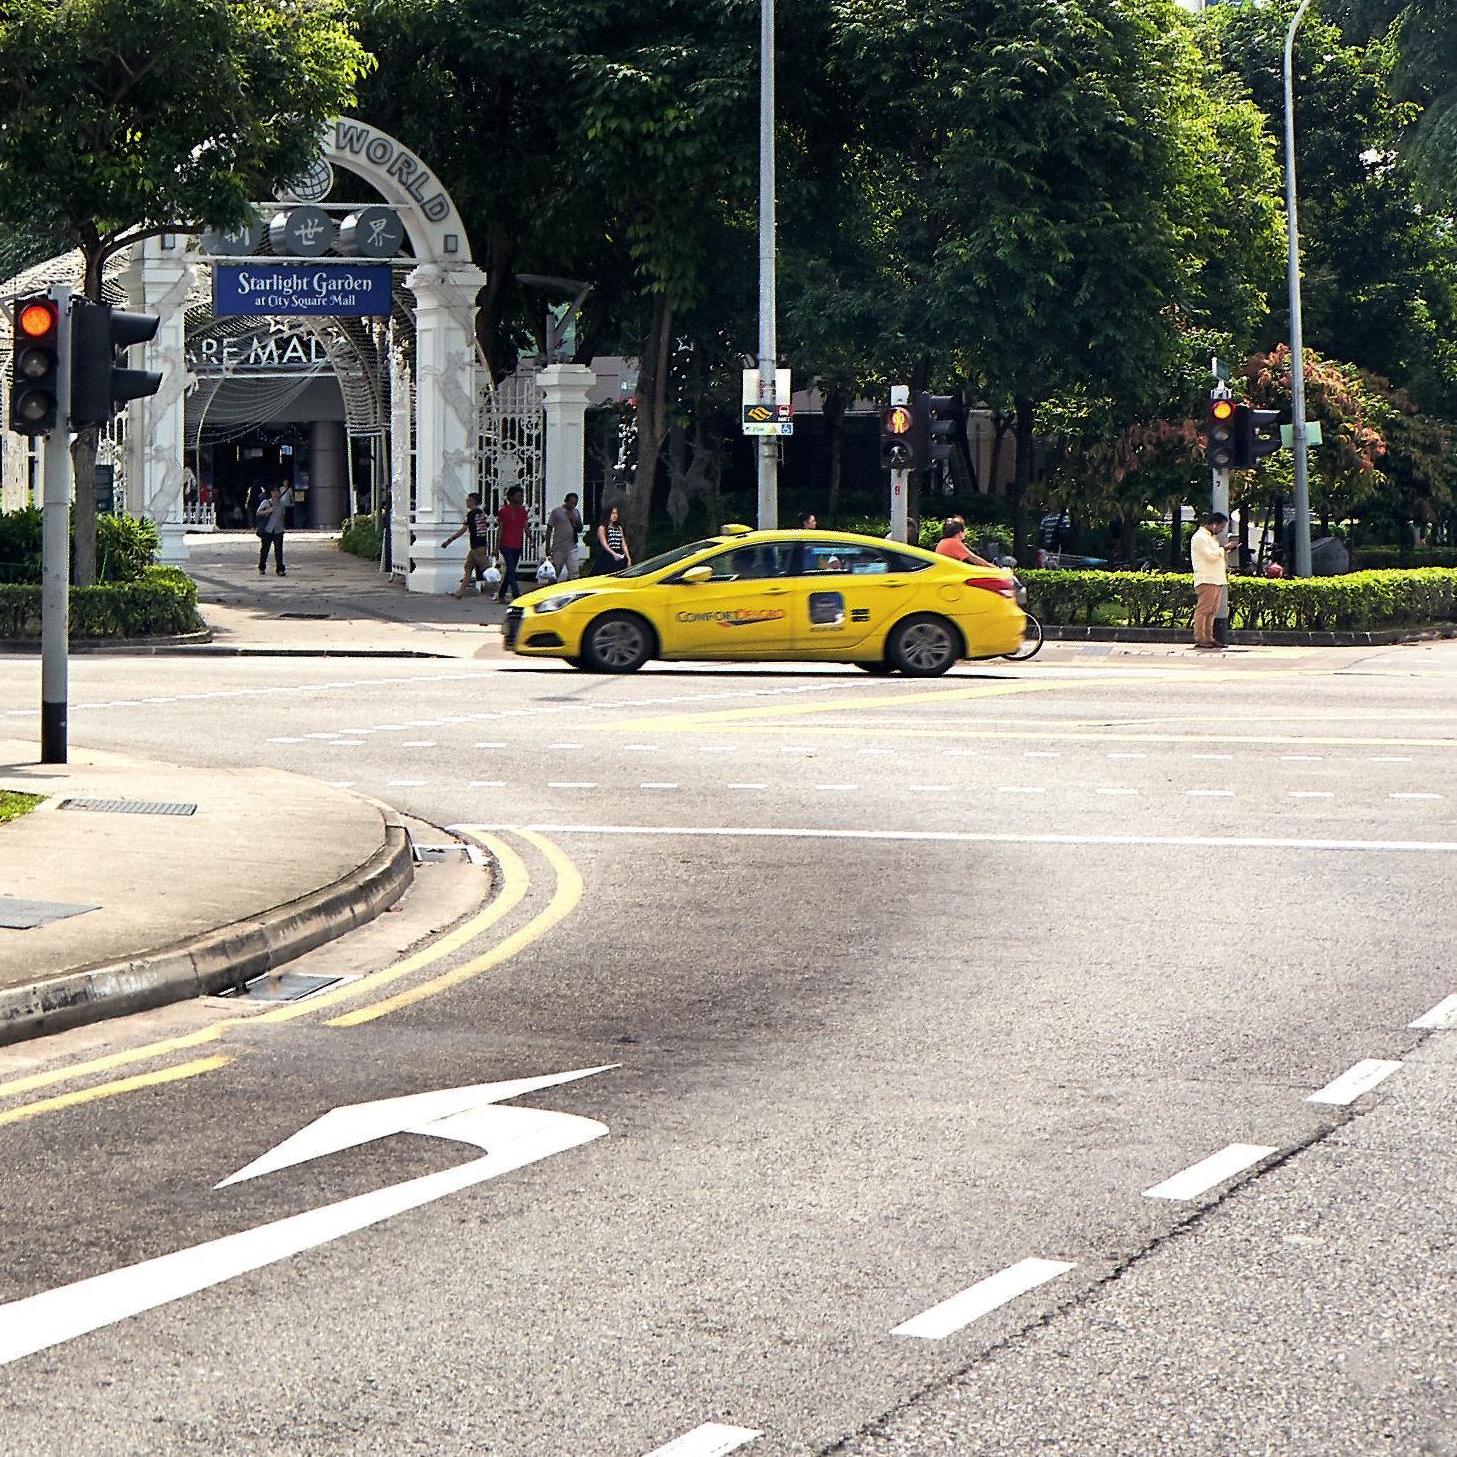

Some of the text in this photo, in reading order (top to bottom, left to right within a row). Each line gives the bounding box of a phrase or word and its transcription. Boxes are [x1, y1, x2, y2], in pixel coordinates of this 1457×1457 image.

[335, 122, 449, 223] WORLD
[238, 272, 372, 297] Starlight Garden
[255, 293, 356, 309] at City Square Mall
